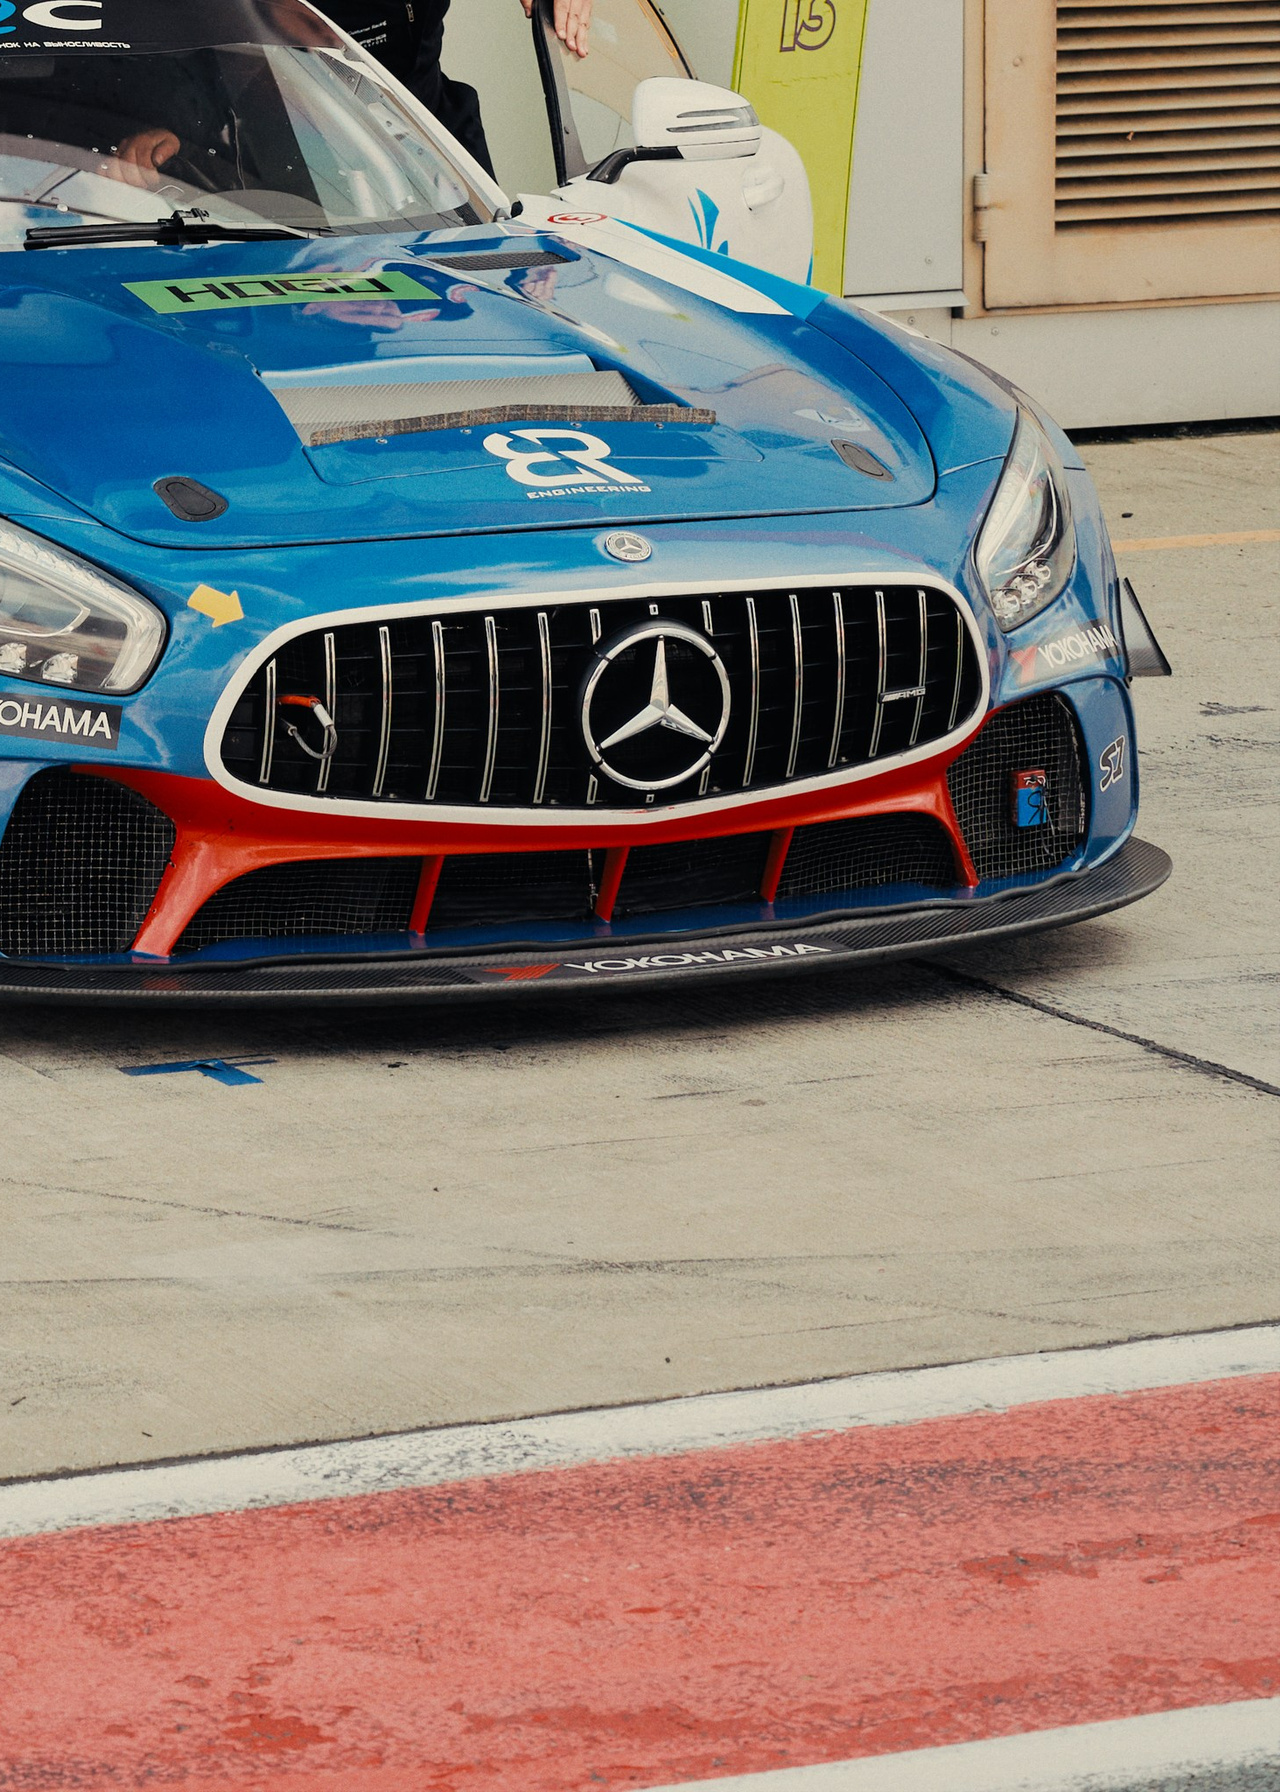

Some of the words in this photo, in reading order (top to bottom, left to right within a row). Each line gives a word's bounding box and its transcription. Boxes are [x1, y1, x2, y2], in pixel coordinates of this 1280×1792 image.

[24, 40, 41, 49] НА
[43, 40, 131, 50] ВЫНОСЛИВОСТЬ
[526, 484, 652, 500] ENGINEERING
[1038, 624, 1118, 668] YOKOHAMA
[563, 943, 832, 974] YOKOHAMA
